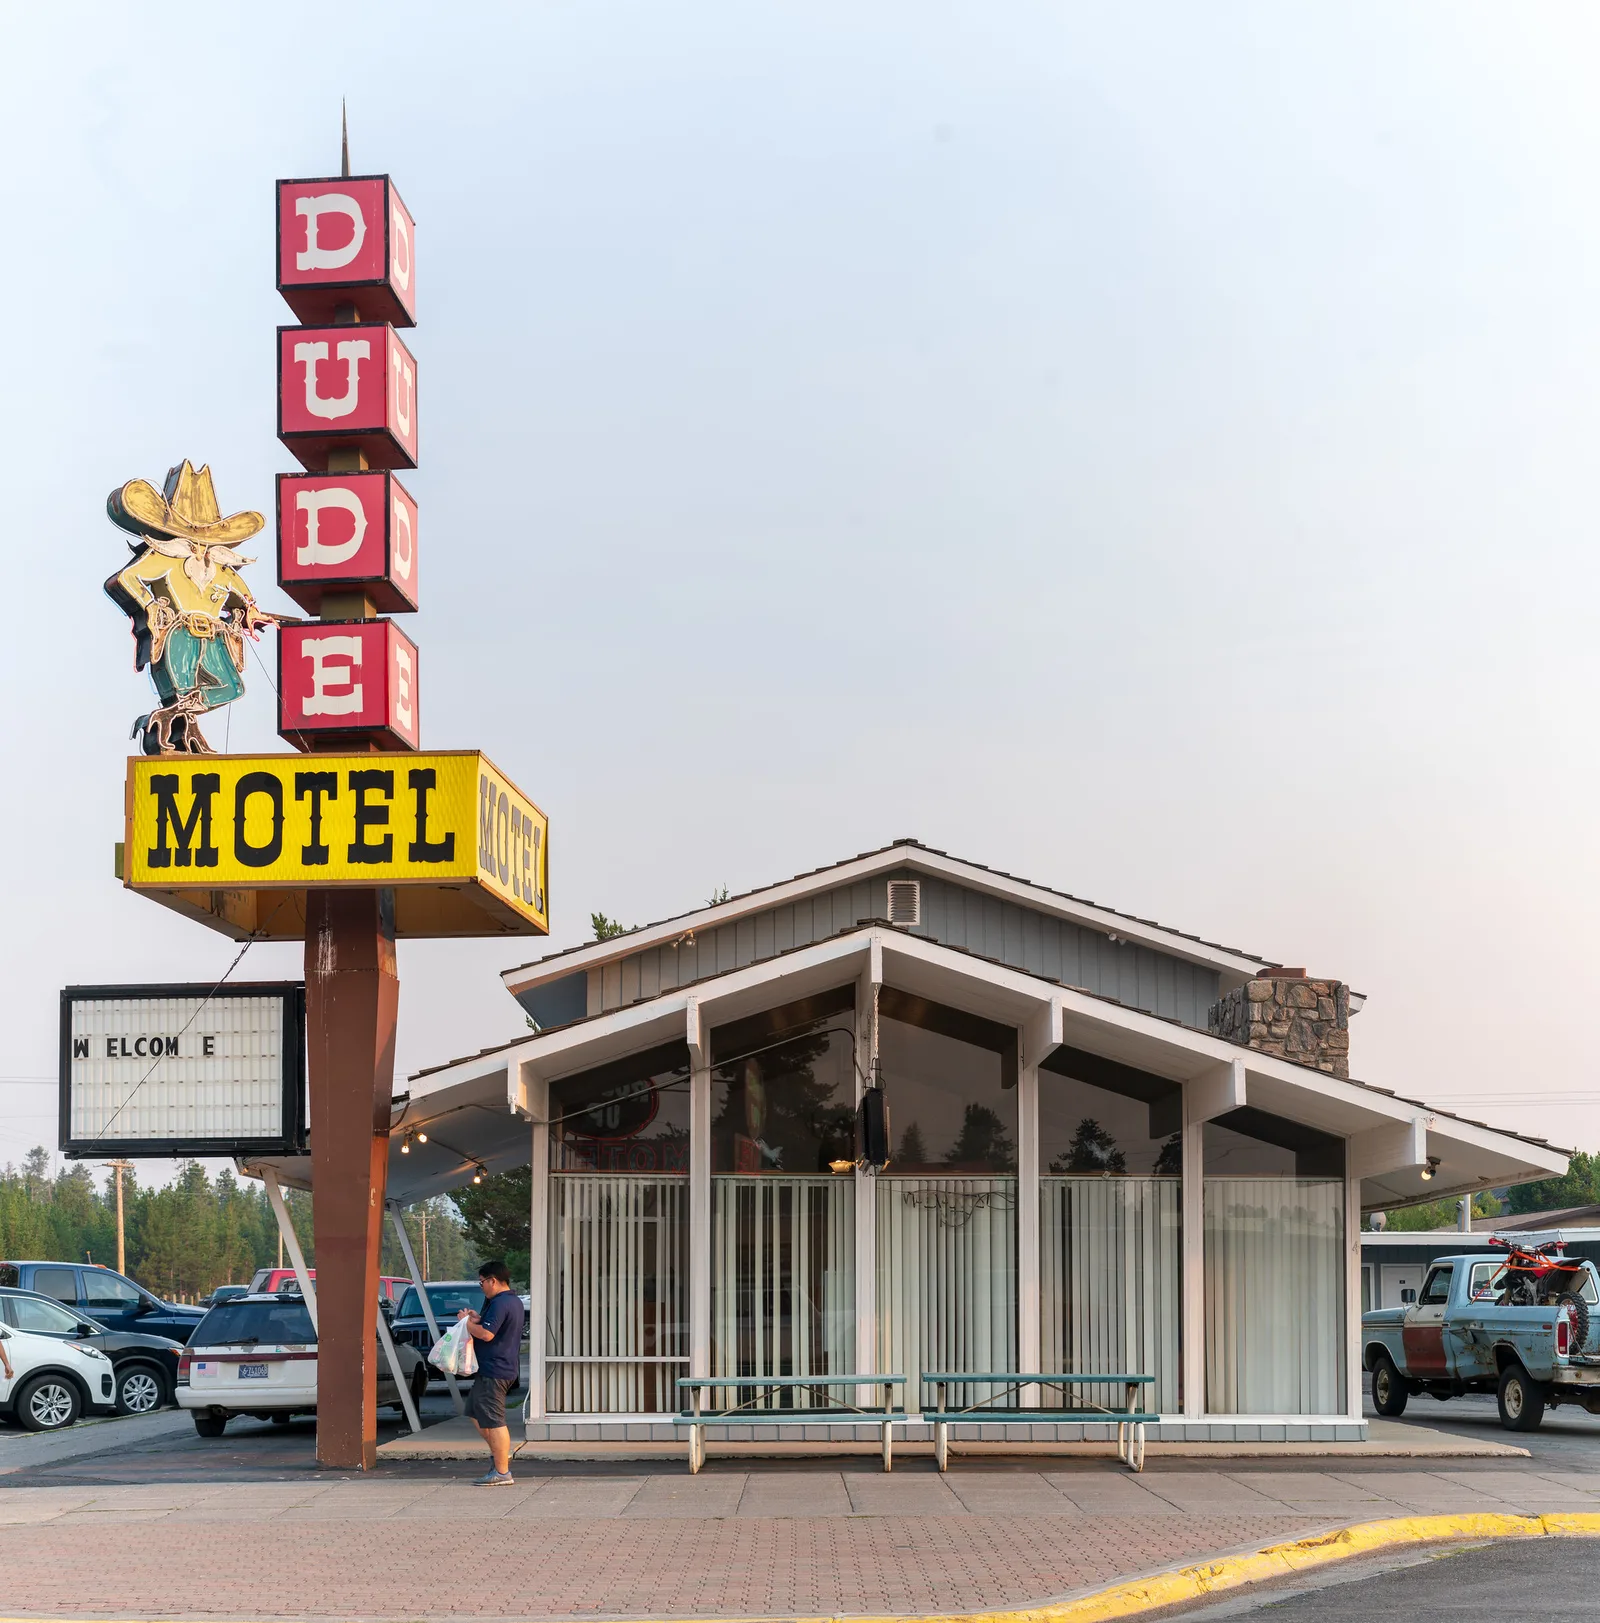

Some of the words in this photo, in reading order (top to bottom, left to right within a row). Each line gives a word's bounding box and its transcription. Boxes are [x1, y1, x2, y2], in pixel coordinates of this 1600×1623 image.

[294, 193, 371, 716] DUDE
[392, 204, 414, 732] DUDE
[147, 768, 455, 868] MOTEL
[479, 772, 545, 915] MOTEL
